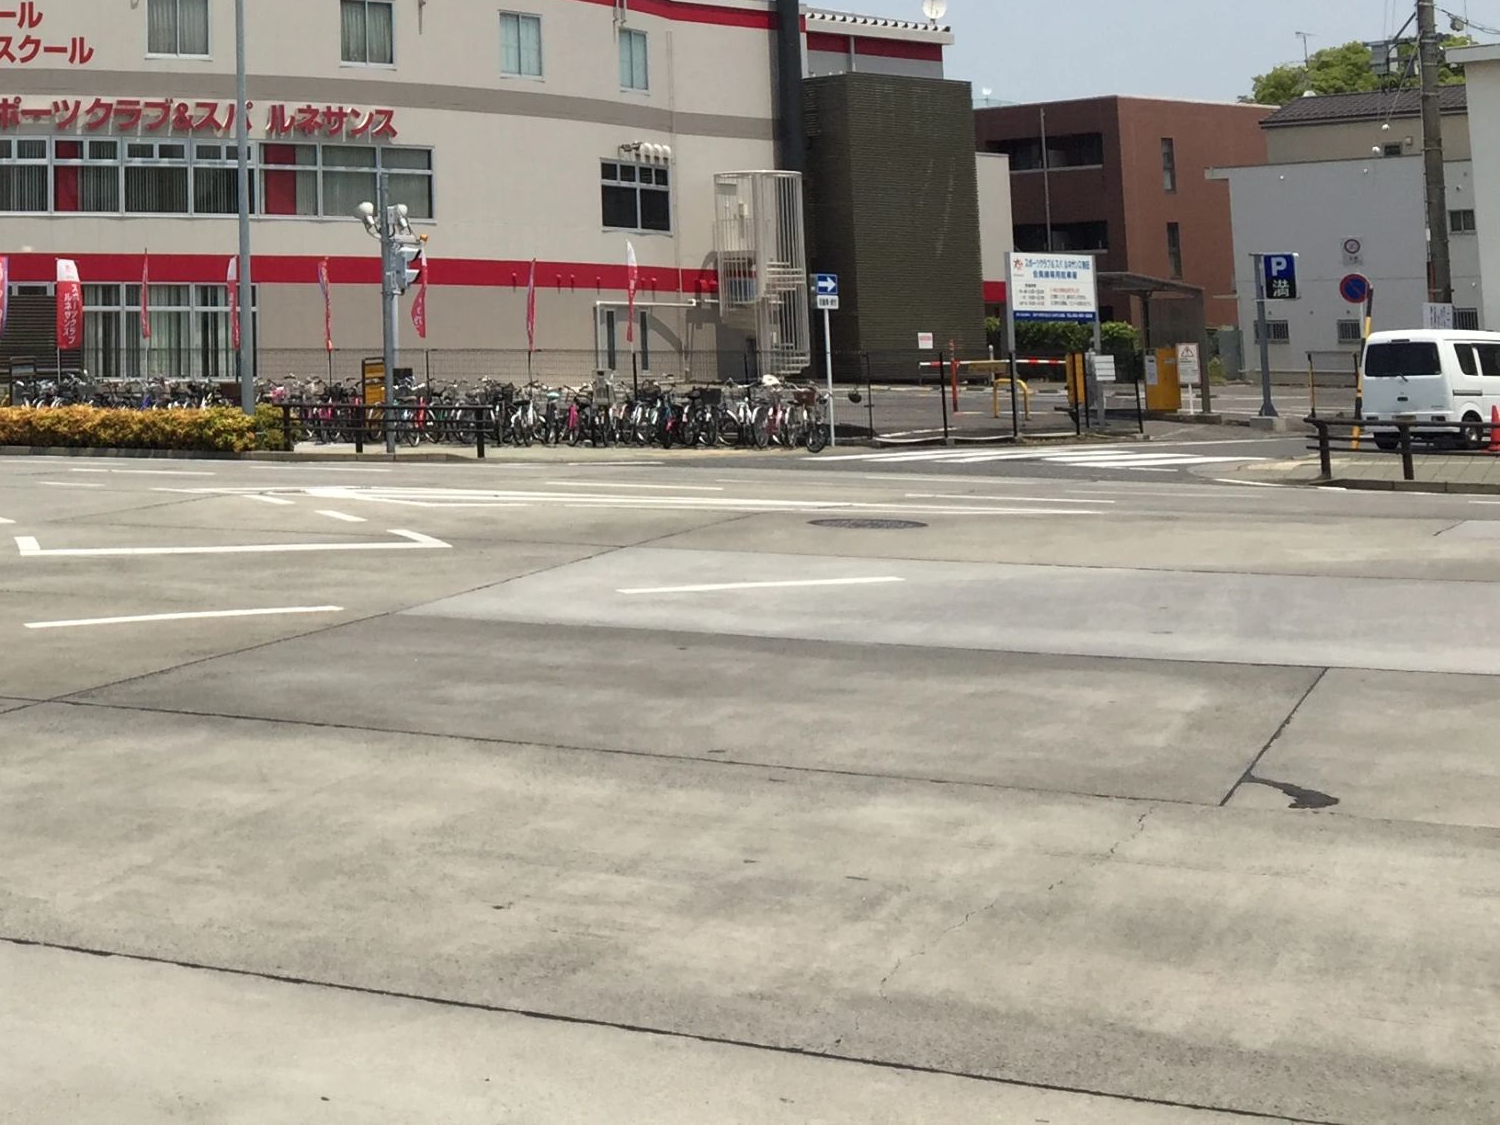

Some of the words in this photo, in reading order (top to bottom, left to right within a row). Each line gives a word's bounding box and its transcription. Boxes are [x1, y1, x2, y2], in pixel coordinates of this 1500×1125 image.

[266, 104, 398, 138] ルネサンス
[1271, 257, 1287, 276] P
[1272, 279, 1290, 297] 満
[62, 293, 73, 337] ルネサンス
[68, 283, 80, 345] スポーツクラブ
